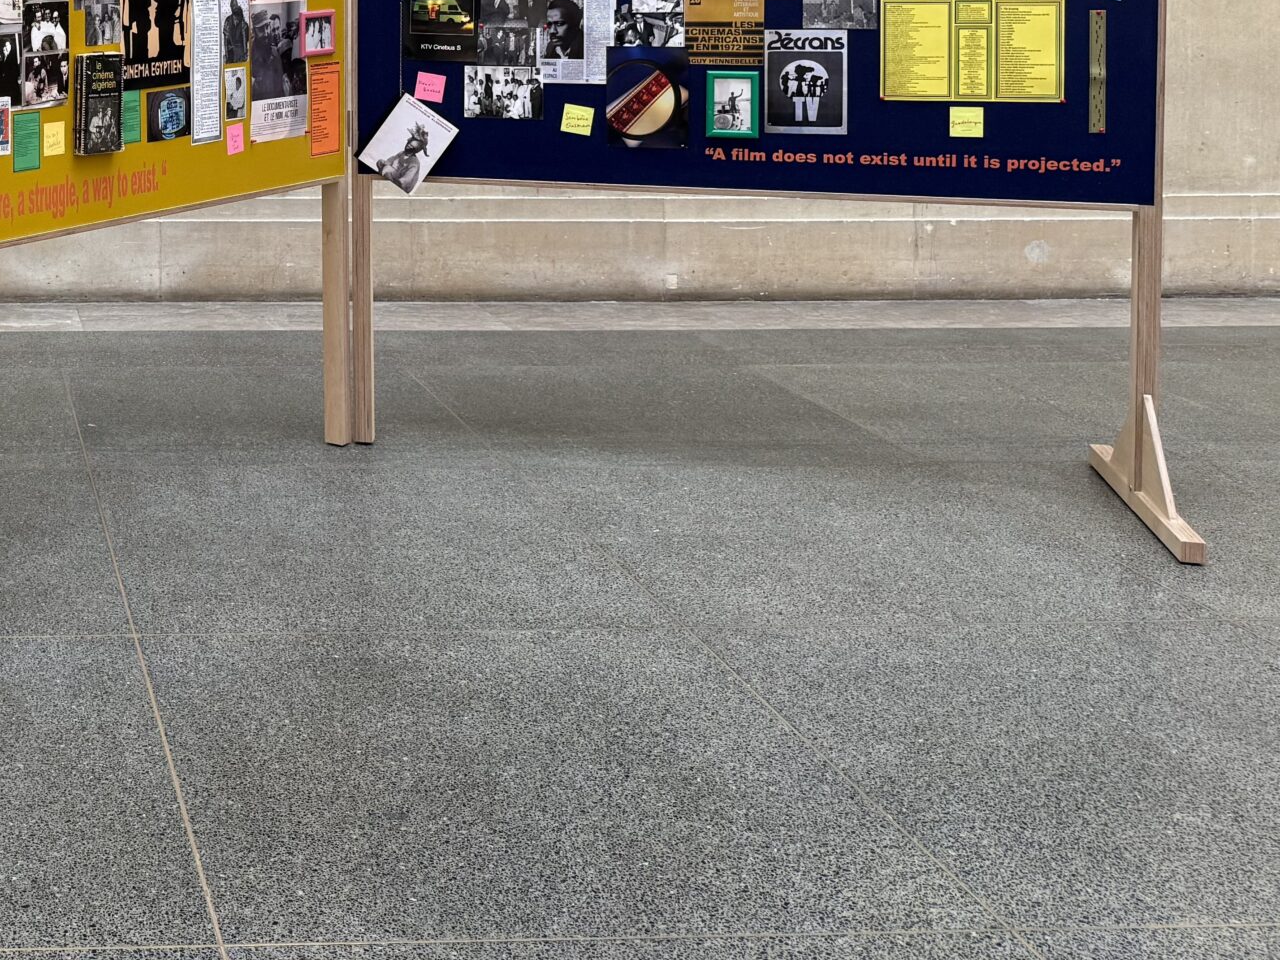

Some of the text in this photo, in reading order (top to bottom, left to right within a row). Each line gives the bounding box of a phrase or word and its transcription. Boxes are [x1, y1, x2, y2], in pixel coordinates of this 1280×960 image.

[690, 28, 741, 36] CINEMAS
[123, 59, 182, 80] CINEMA EGYPTIEN
[793, 96, 820, 122] TV
[731, 147, 766, 162] film
[772, 149, 817, 163] does
[823, 151, 854, 164] not
[859, 151, 908, 166] exist
[914, 153, 957, 168] until
[963, 154, 978, 168] it
[983, 154, 1001, 169] is
[1007, 156, 1121, 173] projected.”
[18, 195, 25, 216] a
[82, 183, 90, 203] a
[92, 177, 115, 208] way
[117, 171, 128, 196] to
